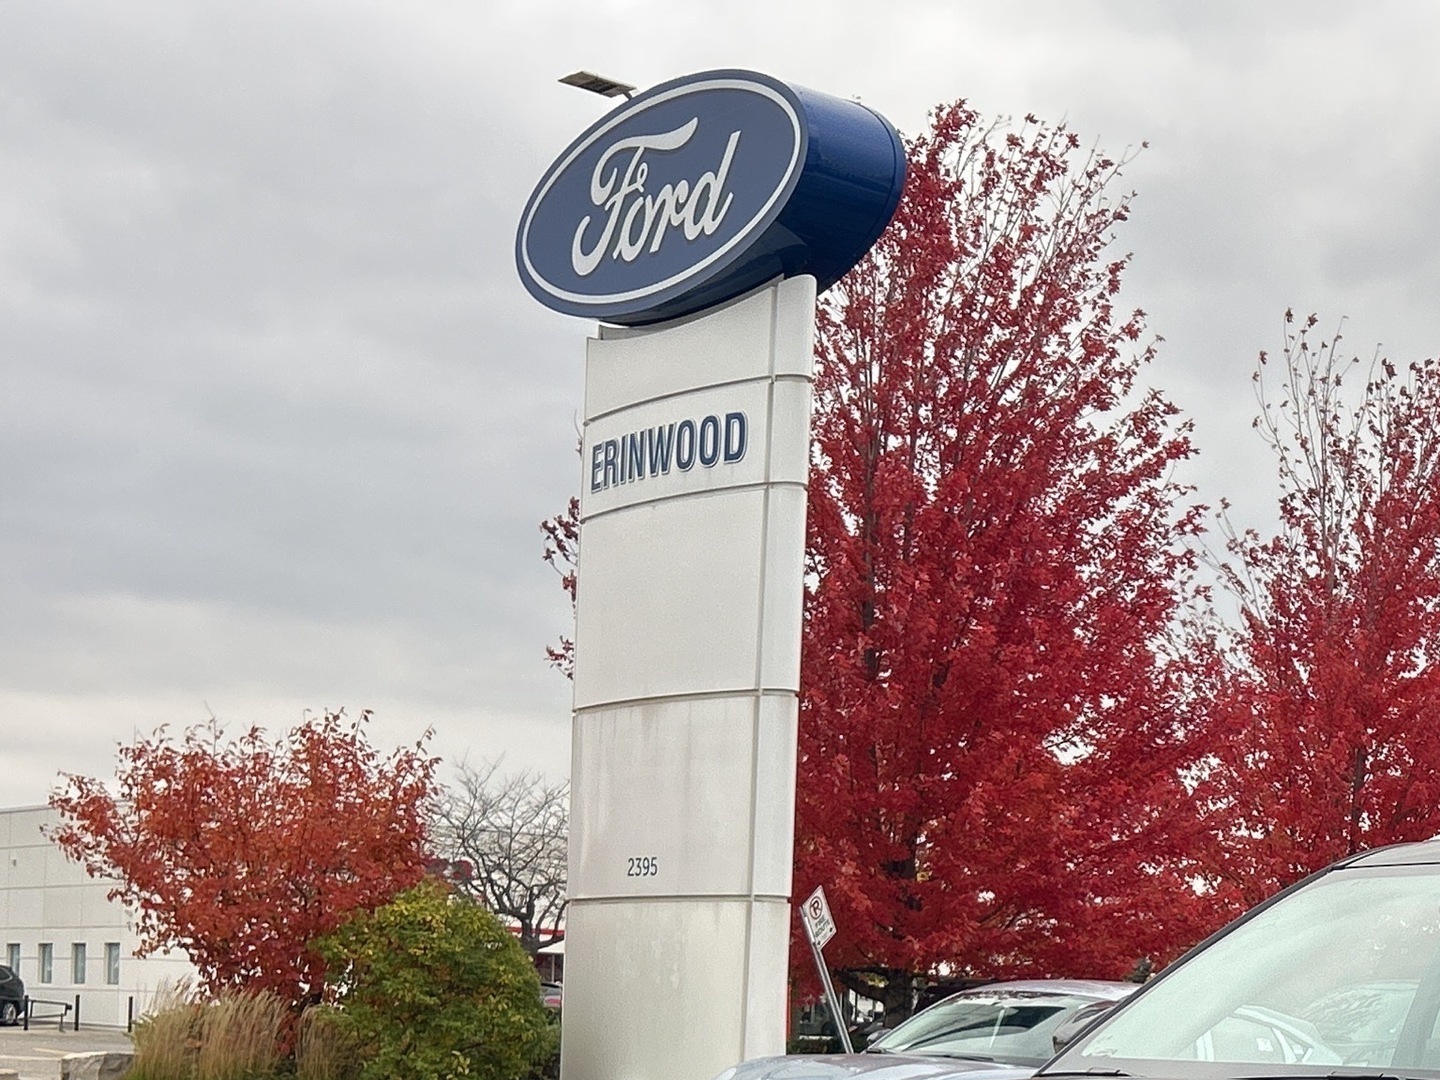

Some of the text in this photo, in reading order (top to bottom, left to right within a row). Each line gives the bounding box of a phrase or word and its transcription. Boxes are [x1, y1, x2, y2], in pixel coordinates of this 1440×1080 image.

[571, 116, 742, 277] Ford
[590, 411, 749, 493] ERINWOOD
[627, 856, 658, 877] 2395
